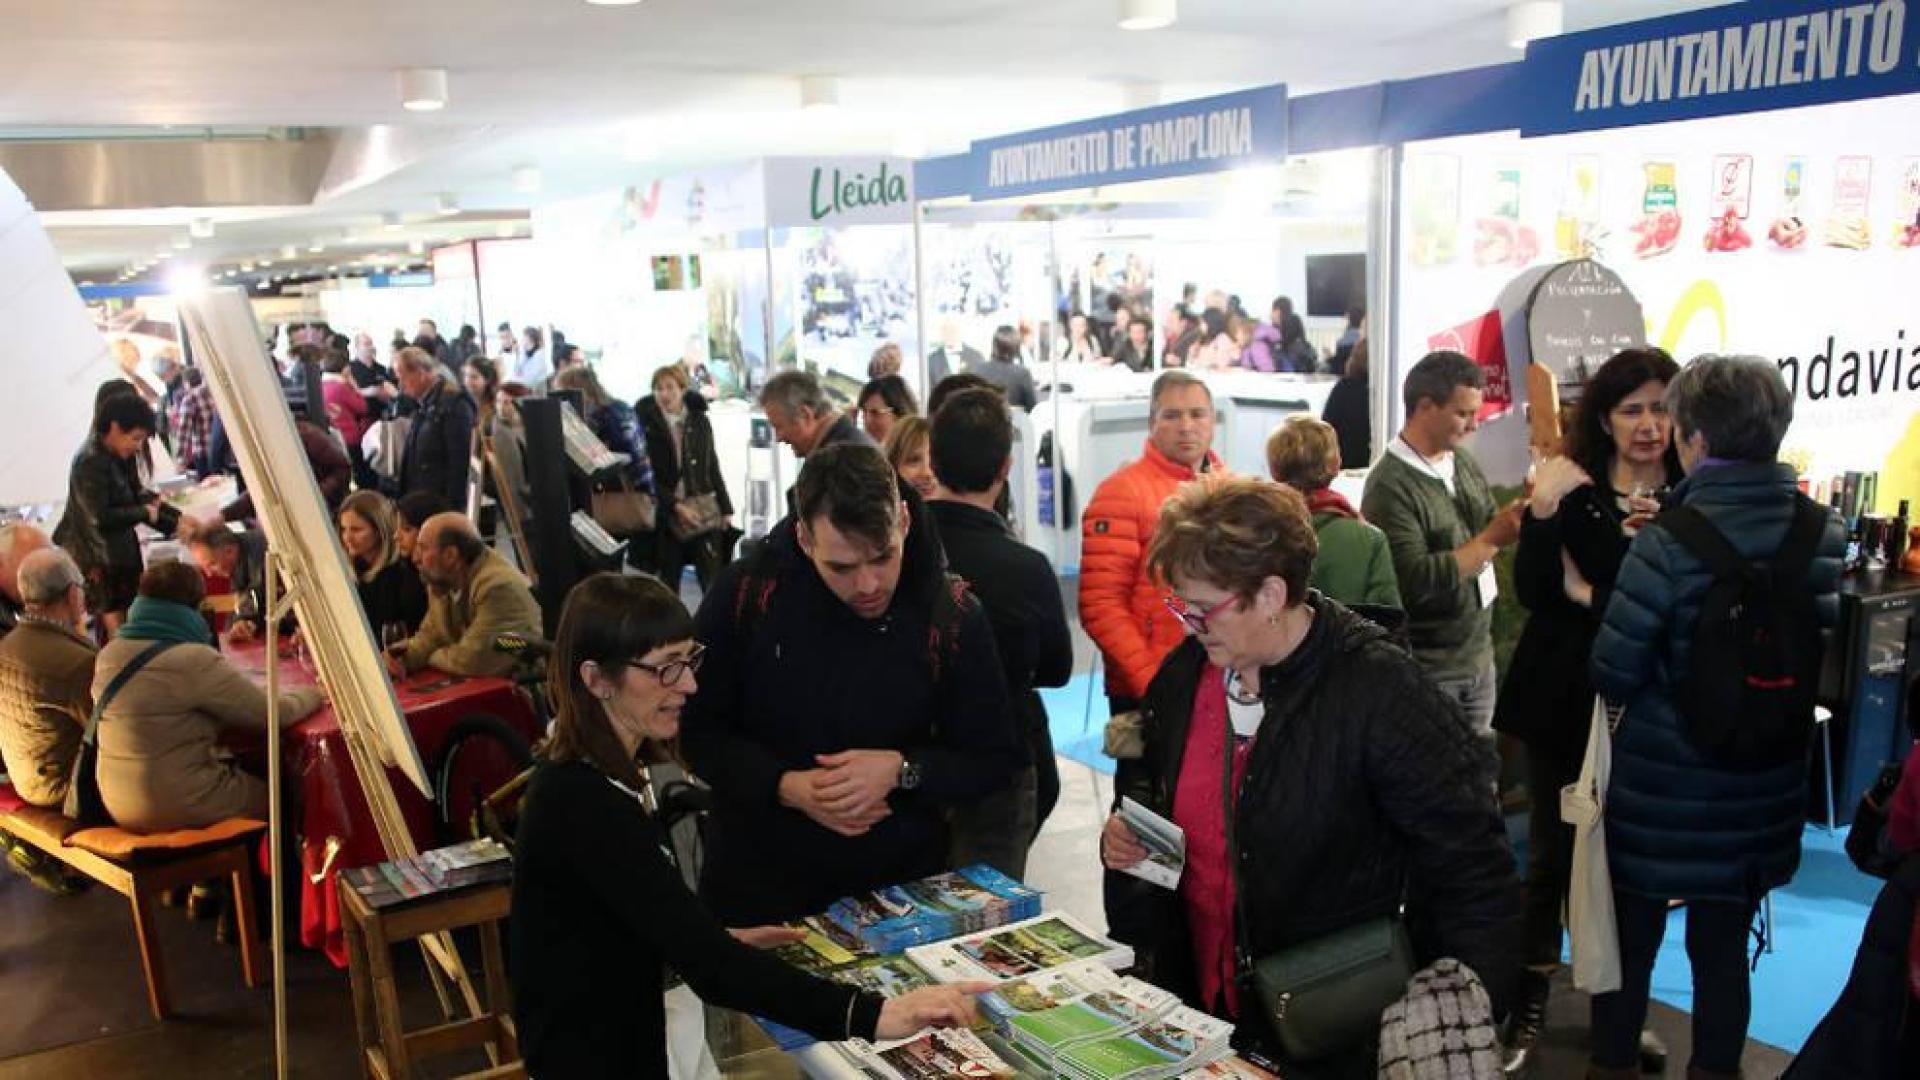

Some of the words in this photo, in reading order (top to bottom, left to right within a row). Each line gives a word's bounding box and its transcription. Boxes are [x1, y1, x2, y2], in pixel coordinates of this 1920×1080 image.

[1574, 0, 1906, 112] AYUNTAMIENTO
[988, 130, 1109, 188] AYUNTAMIENTO
[1112, 125, 1137, 170] DE
[1139, 107, 1252, 168] PAMPLONA
[810, 161, 907, 220] Lleida
